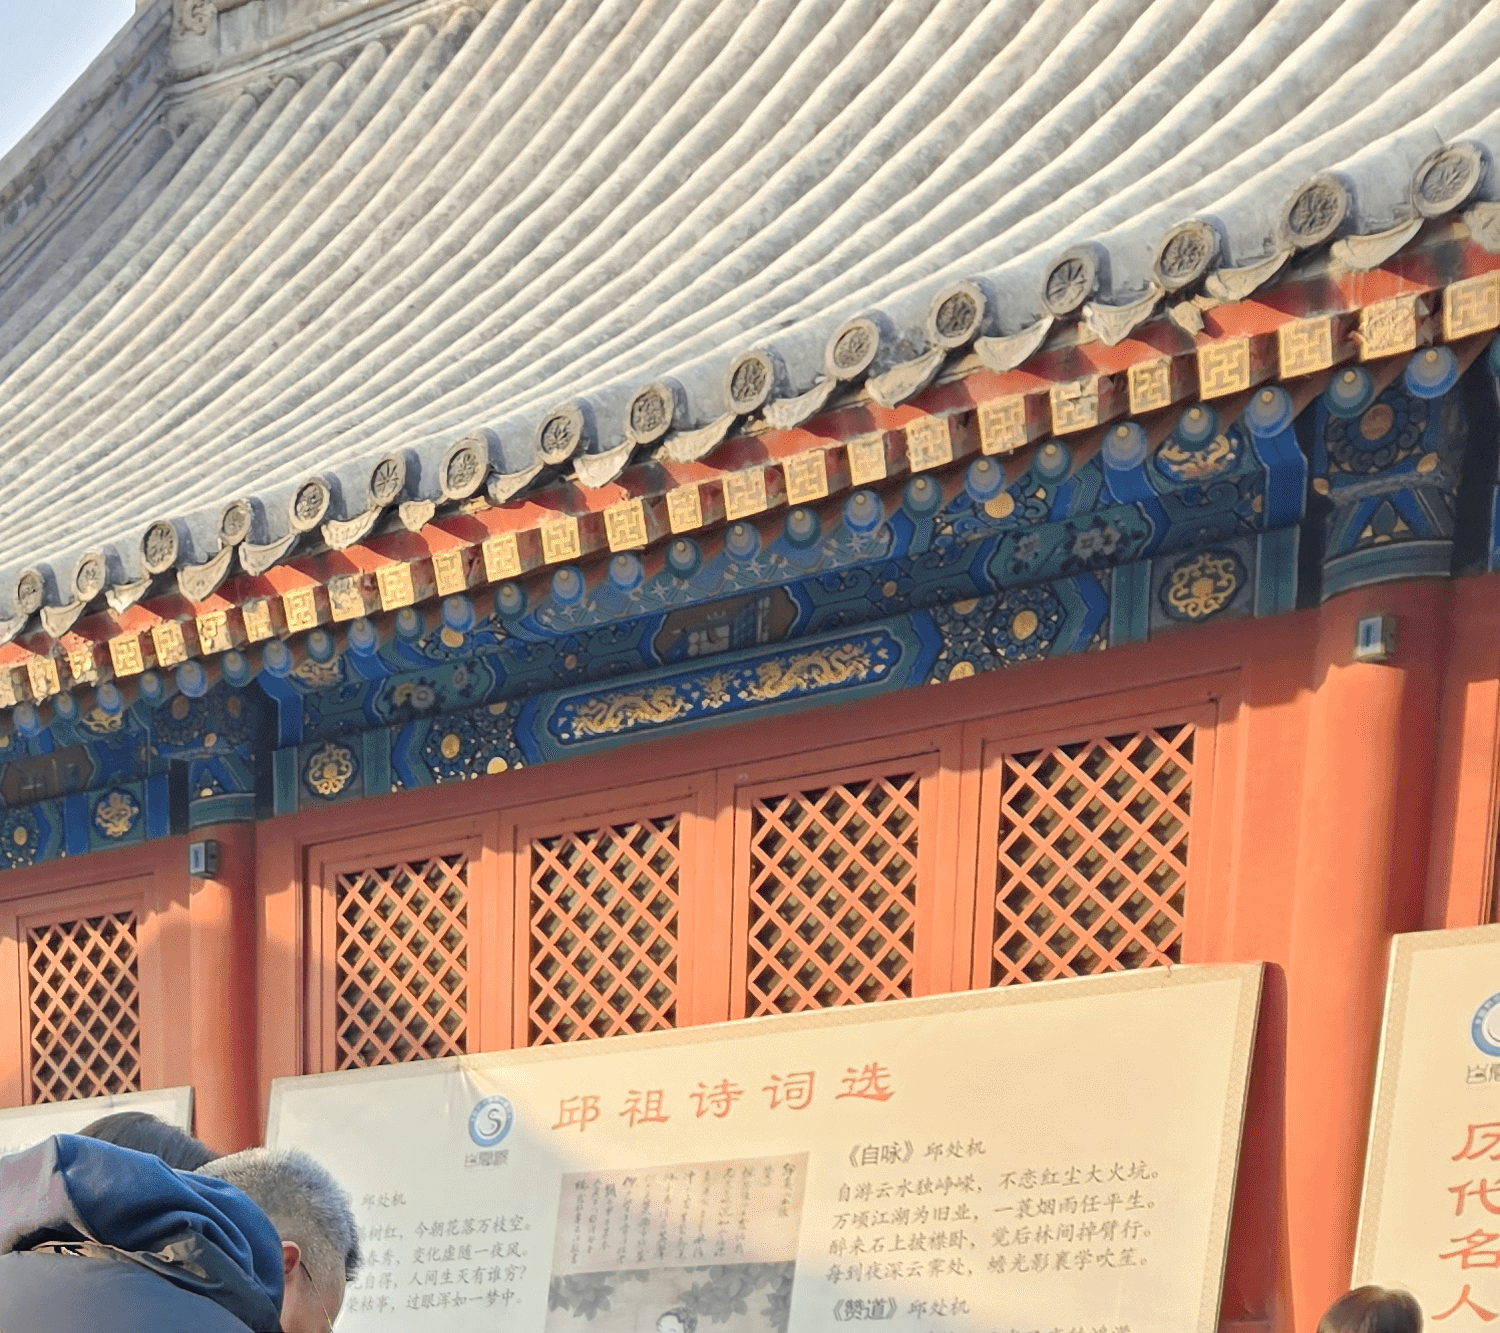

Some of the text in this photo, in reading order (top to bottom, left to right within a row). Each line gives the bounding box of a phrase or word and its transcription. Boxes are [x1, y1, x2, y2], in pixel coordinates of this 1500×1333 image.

[551, 1061, 897, 1132] 邱祖诗词选
